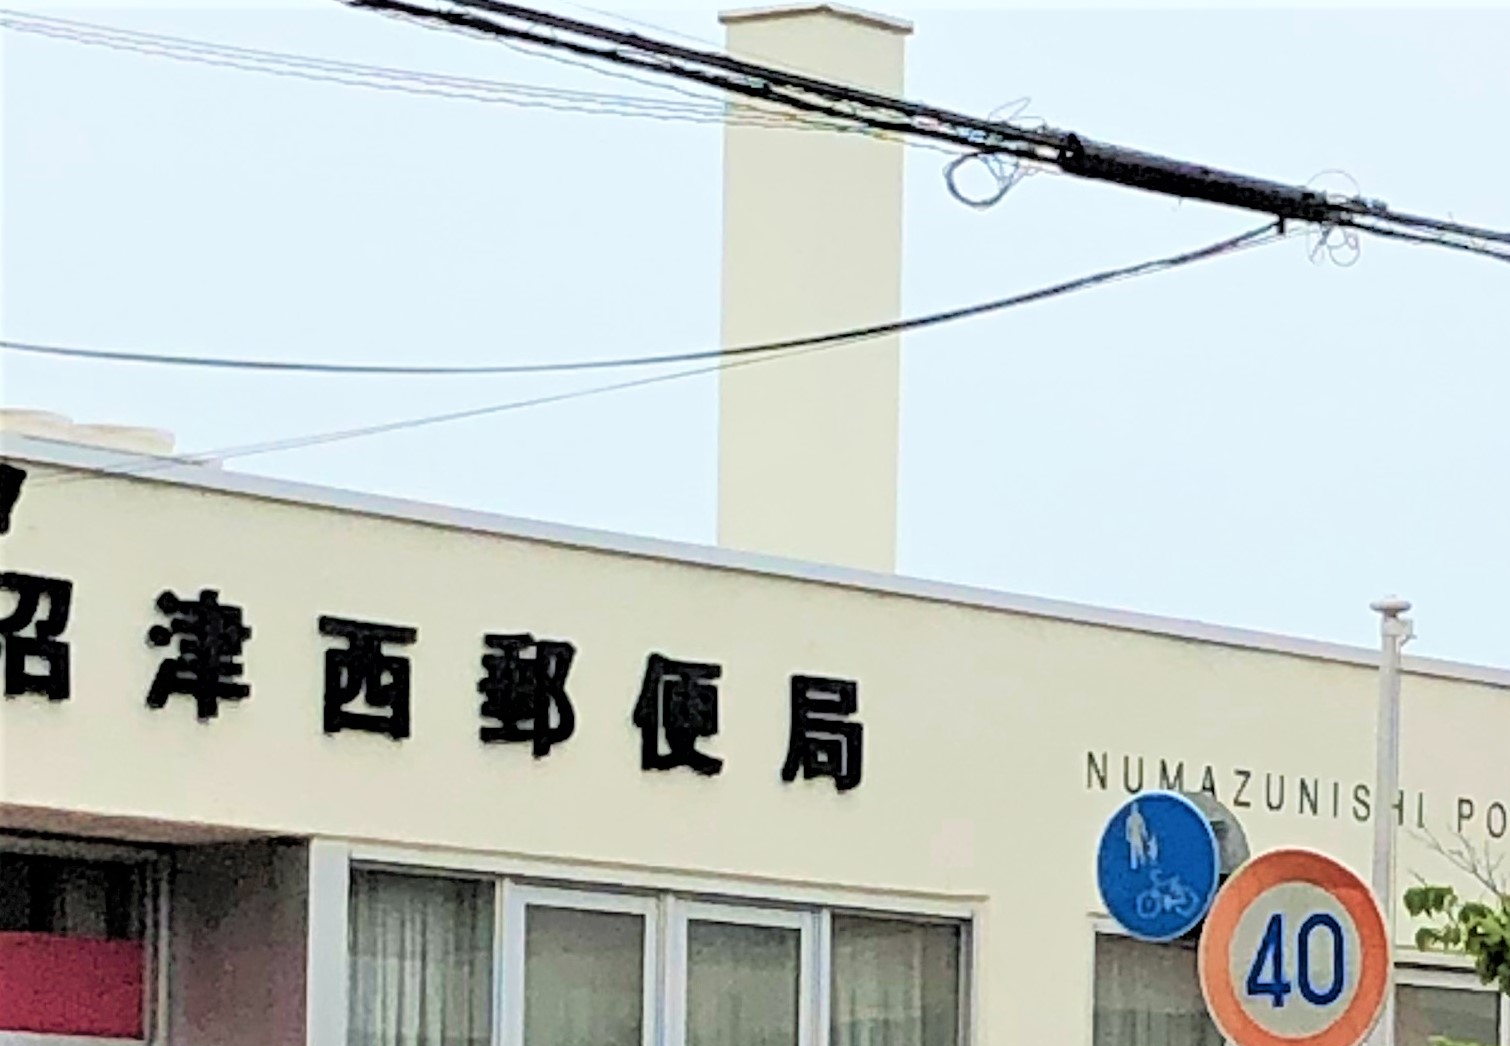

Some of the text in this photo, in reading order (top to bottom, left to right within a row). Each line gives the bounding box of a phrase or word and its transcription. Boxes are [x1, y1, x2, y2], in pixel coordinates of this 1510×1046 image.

[0, 571, 863, 790] 沼津西郵便局
[1087, 751, 1424, 828] NUMAZUNISHI
[1246, 912, 1346, 1008] 40
